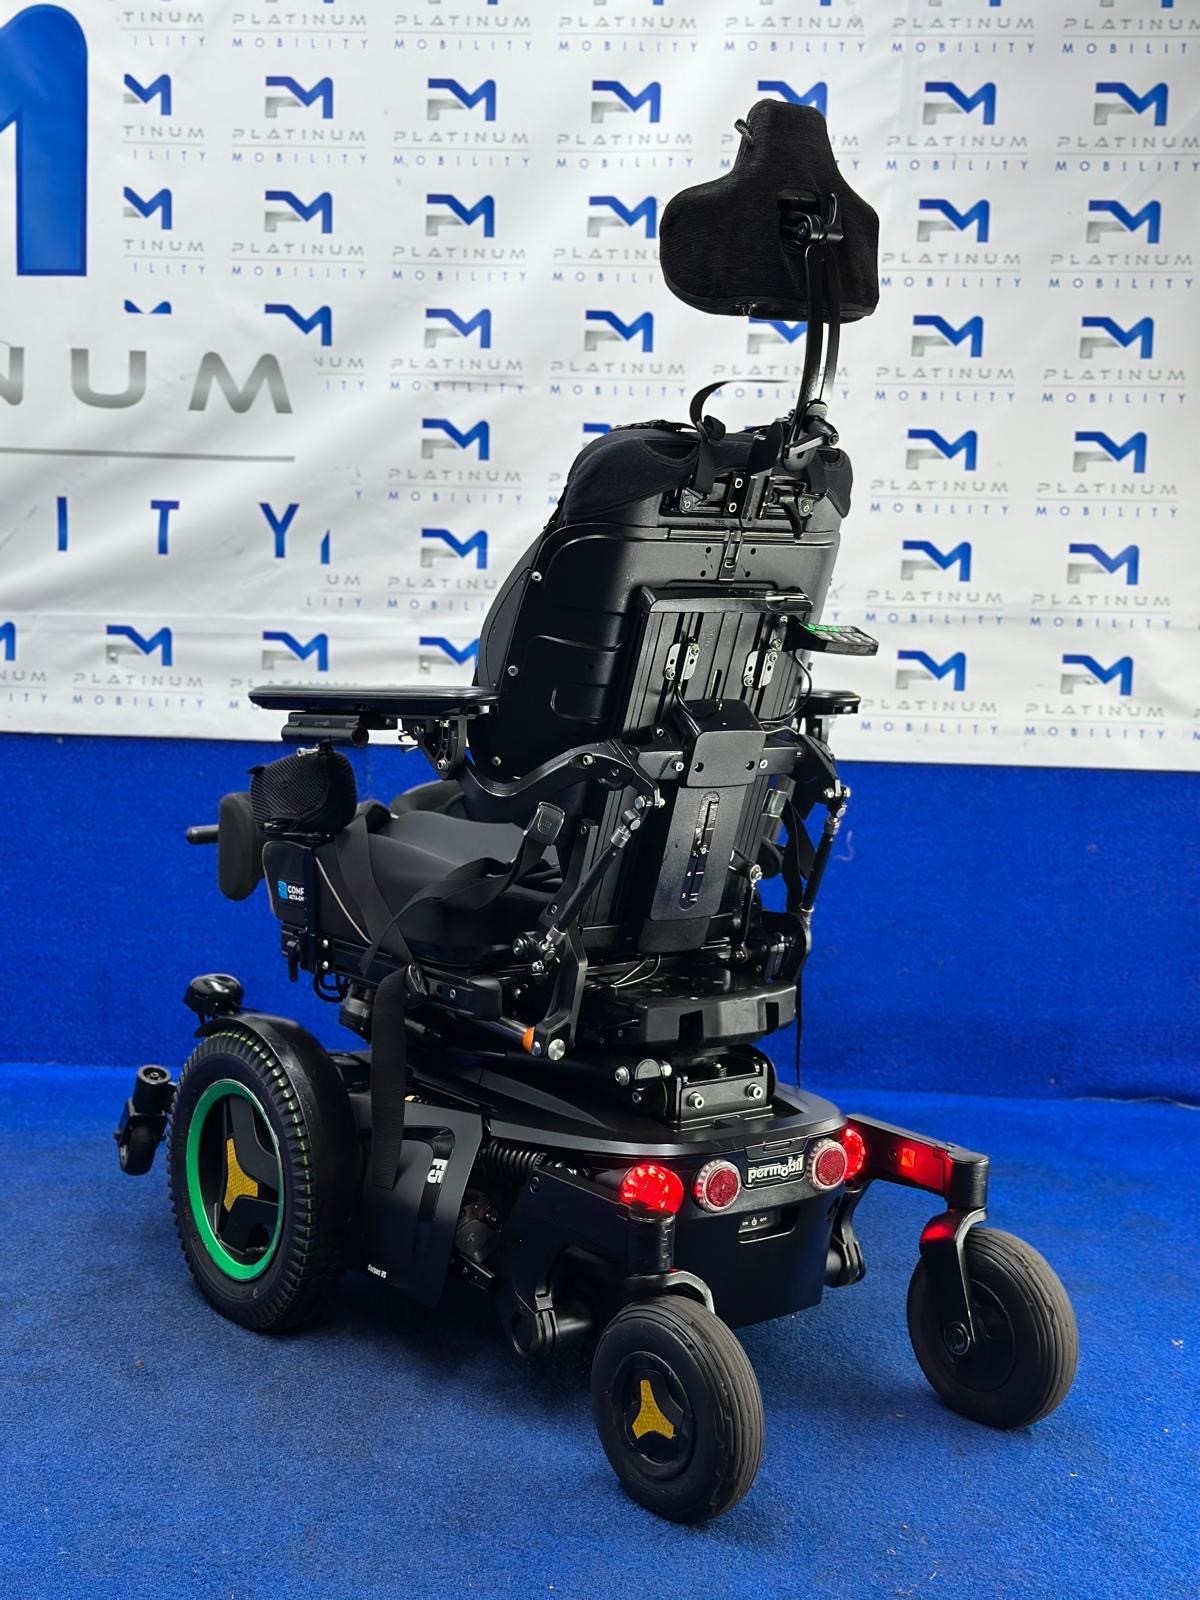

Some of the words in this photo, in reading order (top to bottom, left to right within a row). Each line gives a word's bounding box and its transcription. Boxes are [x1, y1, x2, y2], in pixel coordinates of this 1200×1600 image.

[233, 14, 366, 25] PLATINUM
[395, 15, 530, 27] PLATINUM
[560, 17, 696, 28] PLATINUM
[725, 16, 863, 30] PLATINUM
[893, 17, 1034, 29] PLATINUM
[232, 38, 368, 48] MOBILITY
[394, 39, 531, 50] MOBILITY
[559, 41, 696, 52] MOBILITY
[724, 41, 864, 53] MOBILITY
[892, 41, 1035, 54] MOBILITY
[233, 129, 365, 141] PLATINUM
[394, 131, 528, 143] PLATINUM
[557, 133, 692, 146] PLATINUM
[888, 136, 1028, 147] PLATINUM
[1058, 136, 1200, 148] PLATINUM
[232, 152, 366, 163] MOBILITY
[393, 155, 529, 167] MOBILITY
[555, 157, 693, 168] MOBILITY
[887, 160, 1028, 171] MOBILITY
[232, 243, 364, 255] PLATINUM
[393, 246, 524, 259] PLATINUM
[882, 253, 1021, 264] PLATINUM
[1051, 254, 1192, 265] PLATINUM
[232, 266, 365, 277] MOBILITY
[391, 270, 527, 282] MOBILITY
[881, 277, 1021, 288] MOBILITY
[1048, 278, 1194, 289] MOBILITY
[392, 359, 523, 371] PLATINUM
[550, 360, 684, 374] PLATINUM
[877, 367, 1014, 379] PLATINUM
[1044, 369, 1186, 380] PLATINUM
[549, 384, 685, 396] MOBILITY
[875, 391, 1015, 402] MOBILITY
[1042, 393, 1186, 404] MOBILITY
[389, 469, 520, 481] PLATINUM
[872, 480, 1008, 492] PLATINUM
[1037, 483, 1177, 494] PLATINUM
[388, 491, 521, 504] MOBILITY
[870, 503, 1008, 515] MOBILITY
[1036, 506, 1177, 517] MOBILITY
[866, 590, 1002, 603] PLATINUM
[1030, 594, 1169, 607] PLATINUM
[865, 613, 1007, 625] MOBILITY
[1029, 616, 1170, 629] MOBILITY
[73, 673, 202, 686] PLATINUM
[72, 694, 202, 707] MOBILITY
[862, 700, 996, 714] PLATINUM
[1026, 703, 1165, 717] PLATINUM
[861, 721, 998, 735] MOBILITY
[1024, 726, 1164, 739] MOBILITY
[748, 1154, 804, 1183] permobil
